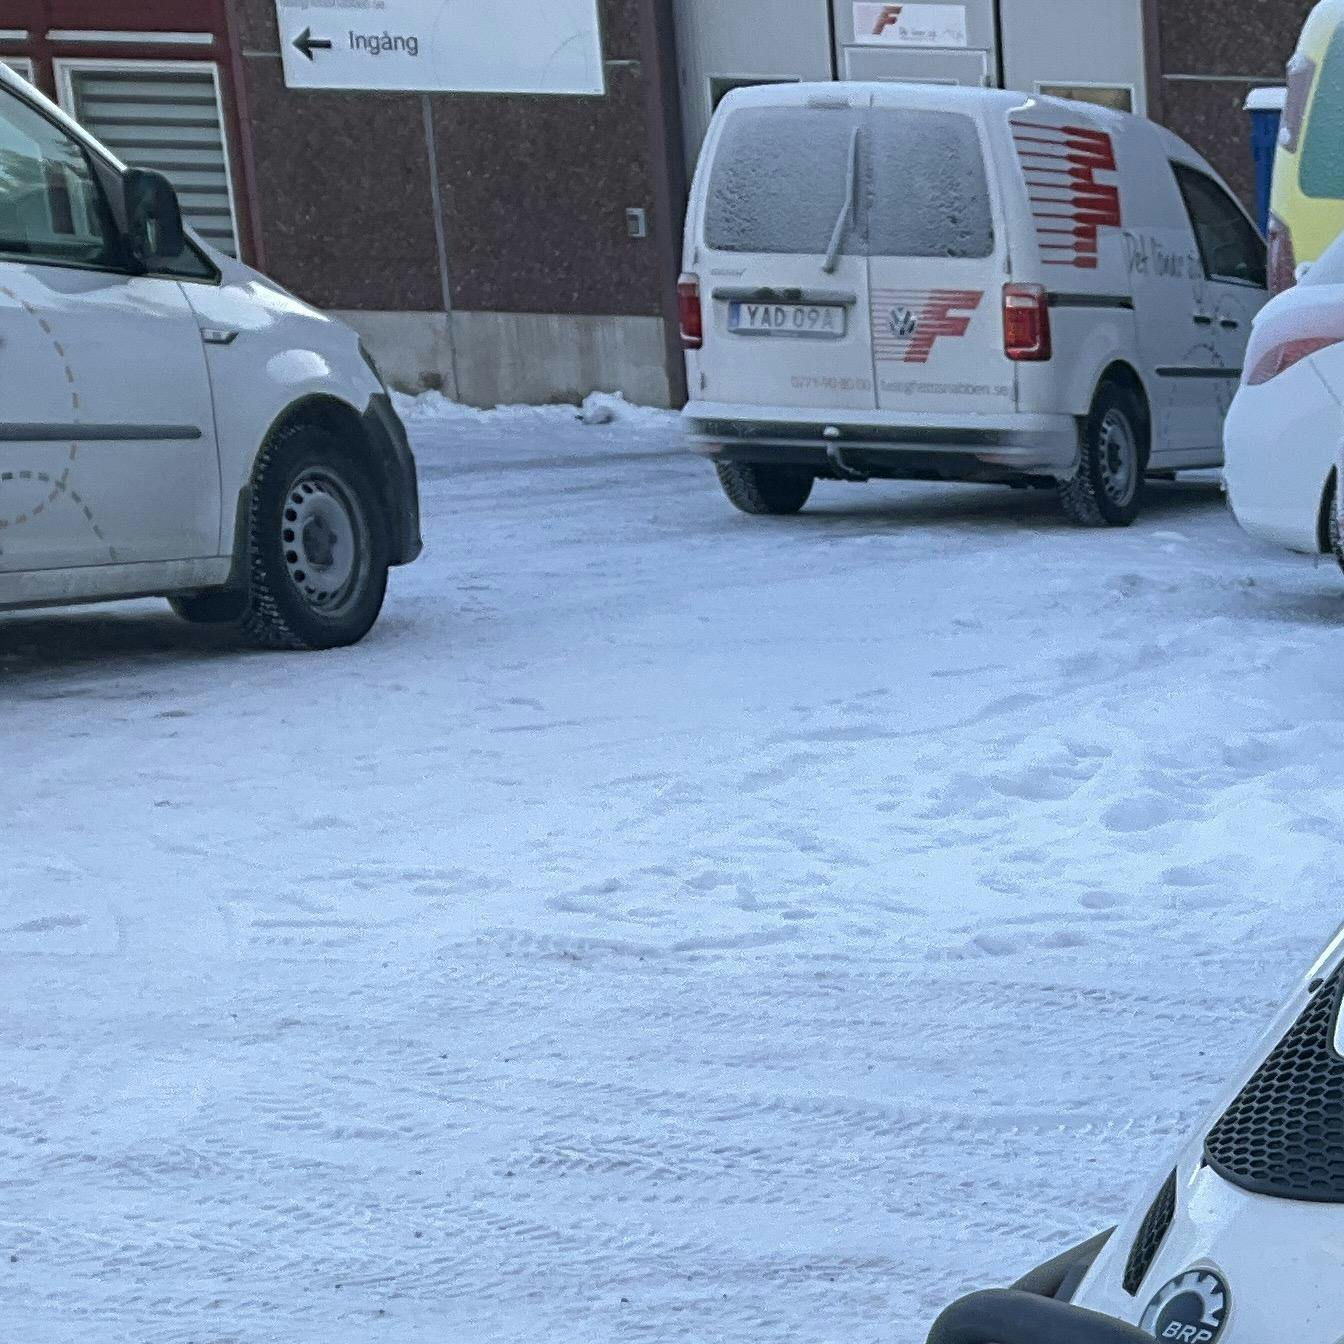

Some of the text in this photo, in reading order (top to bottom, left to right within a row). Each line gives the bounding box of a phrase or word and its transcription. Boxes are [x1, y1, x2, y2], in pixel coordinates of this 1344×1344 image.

[349, 31, 419, 56] Ingång
[747, 305, 786, 328] YAD
[1161, 1320, 1213, 1344] BRP
